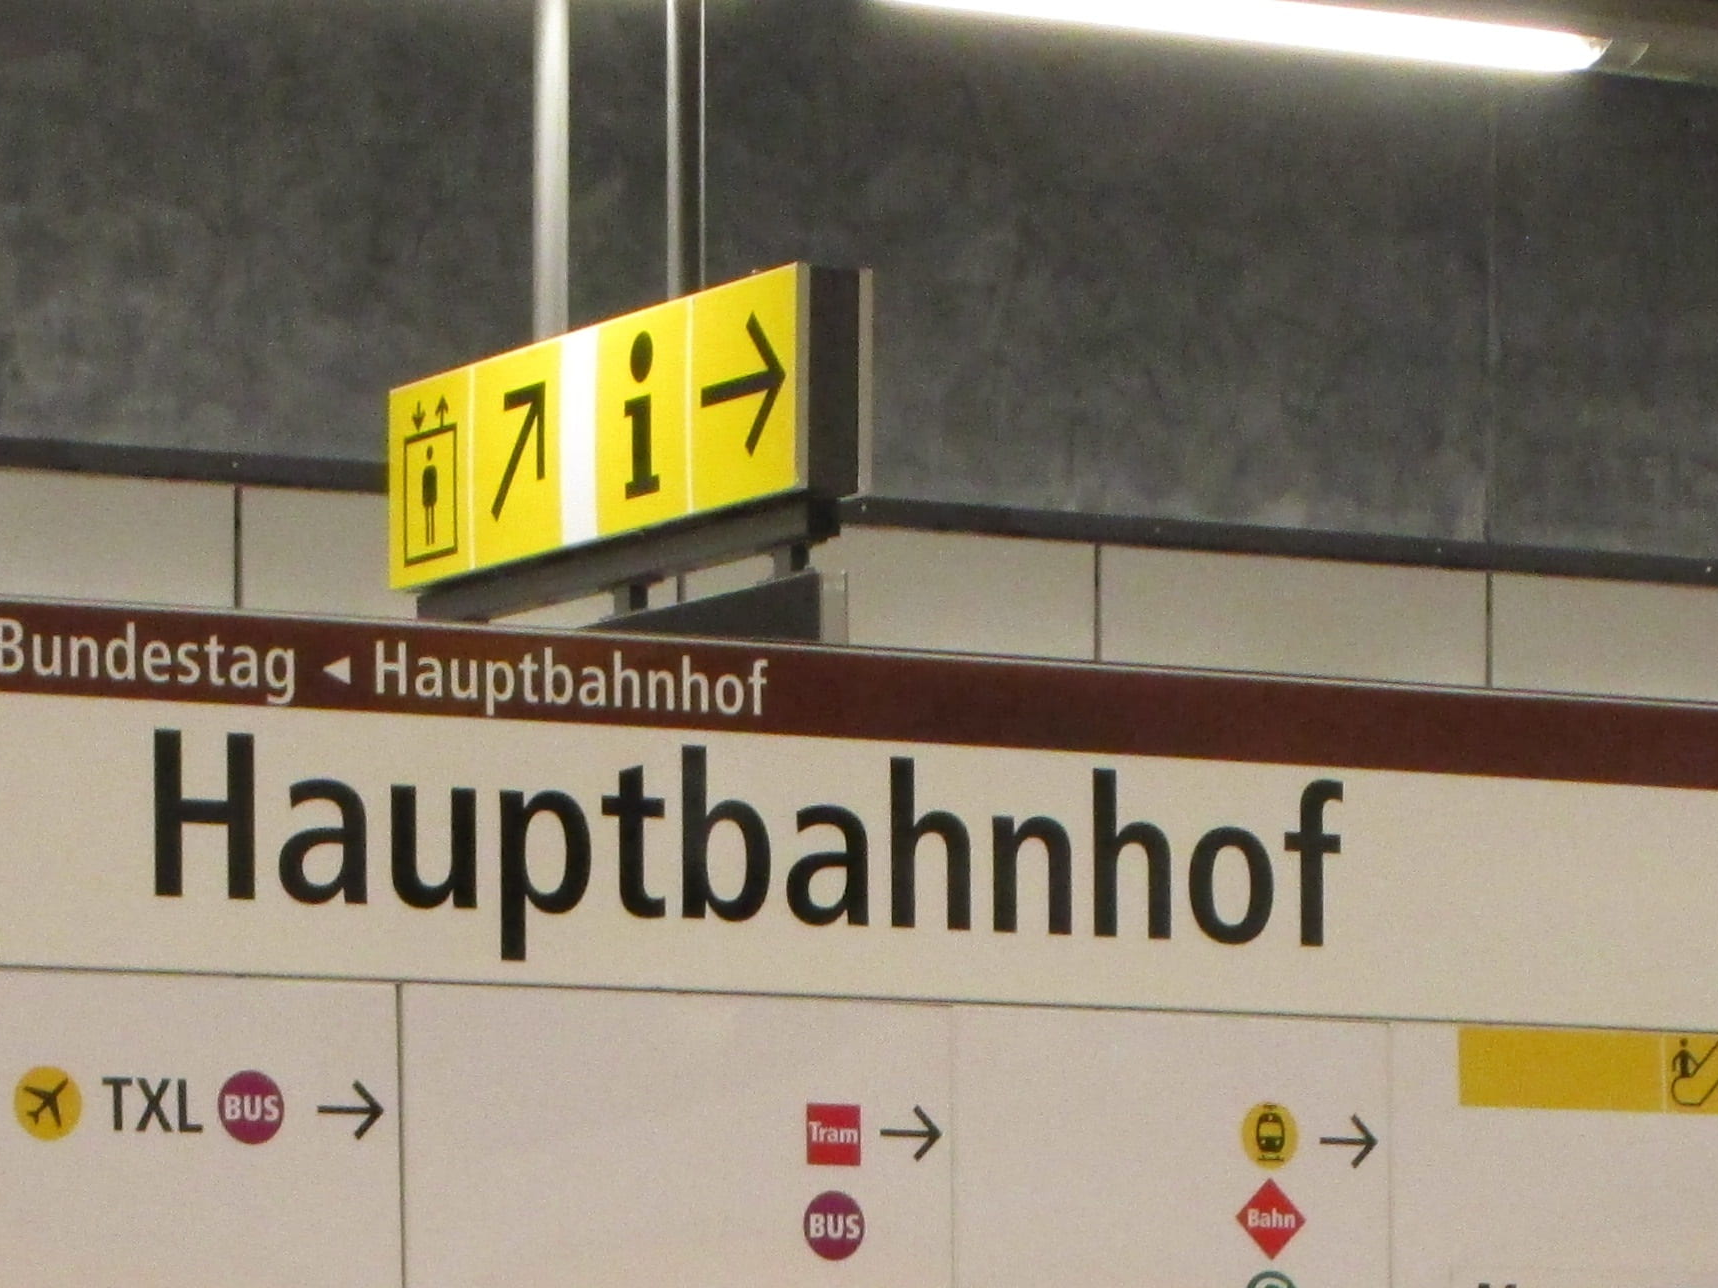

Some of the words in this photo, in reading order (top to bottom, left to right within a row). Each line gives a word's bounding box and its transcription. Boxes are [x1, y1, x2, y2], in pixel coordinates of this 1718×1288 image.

[373, 640, 769, 716] Hauptbahnhof
[152, 728, 1344, 961] Hauptbahnhof
[102, 1076, 204, 1134] TXL
[224, 1093, 280, 1123] BUS
[808, 1121, 859, 1145] Tram
[809, 1213, 862, 1240] BUS
[1247, 1207, 1297, 1230] Bahn
